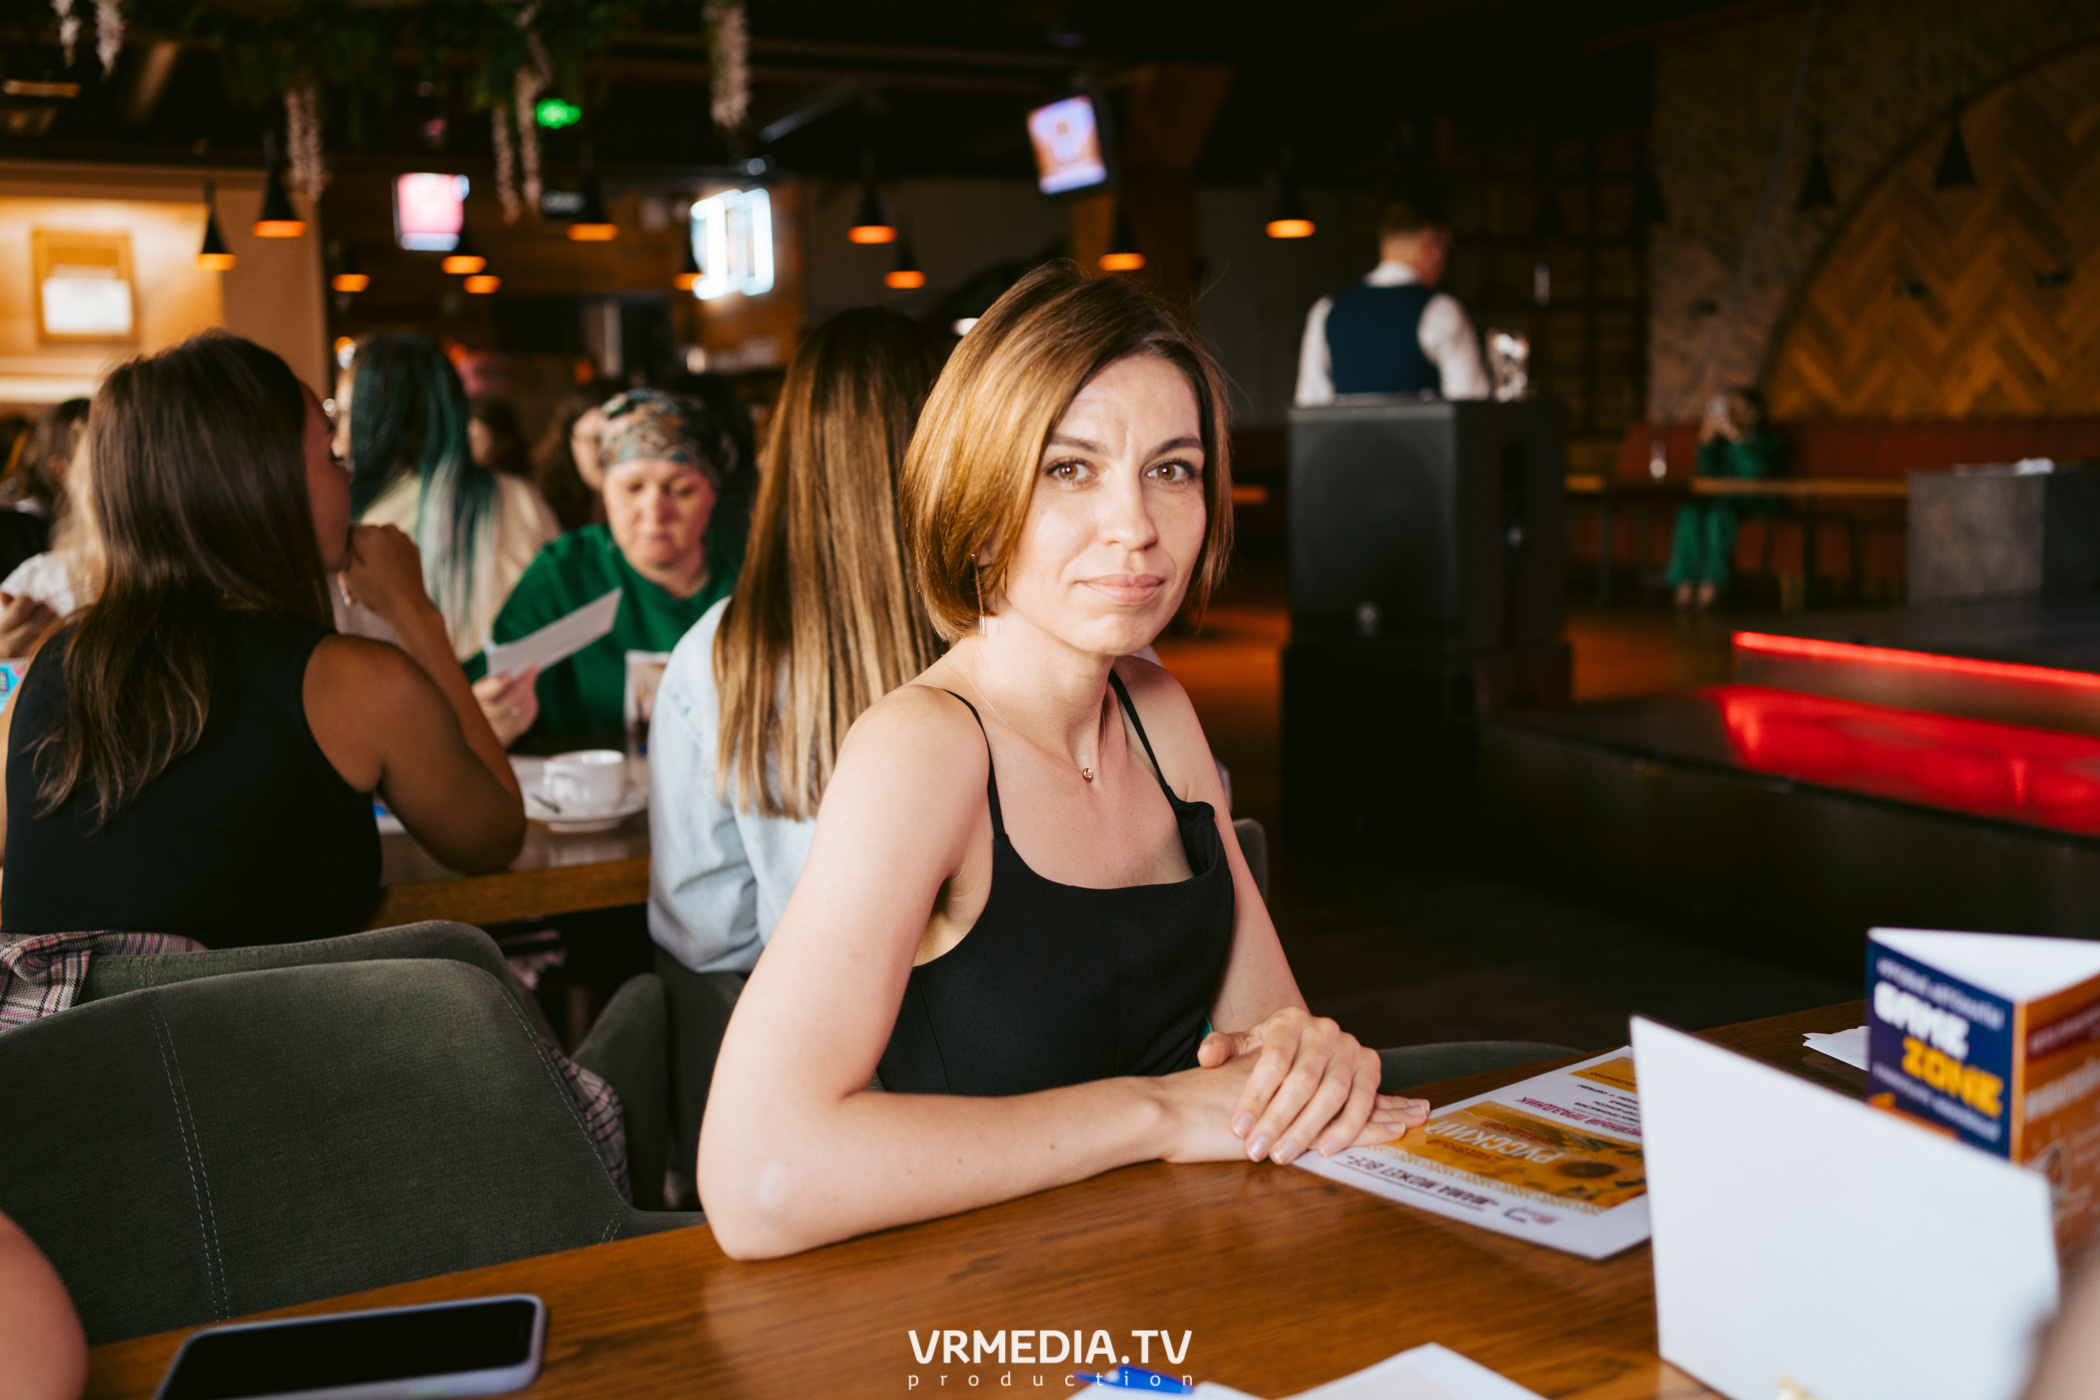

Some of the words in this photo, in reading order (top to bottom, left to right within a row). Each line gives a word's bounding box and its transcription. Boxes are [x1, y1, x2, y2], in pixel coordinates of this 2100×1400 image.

[1902, 1035, 2004, 1119] ZONE
[1514, 1097, 1589, 1121] ПРАЗДНИК
[1425, 1120, 1564, 1164] РУССКИЙ
[1381, 1168, 1438, 1189] МОЖЕТ
